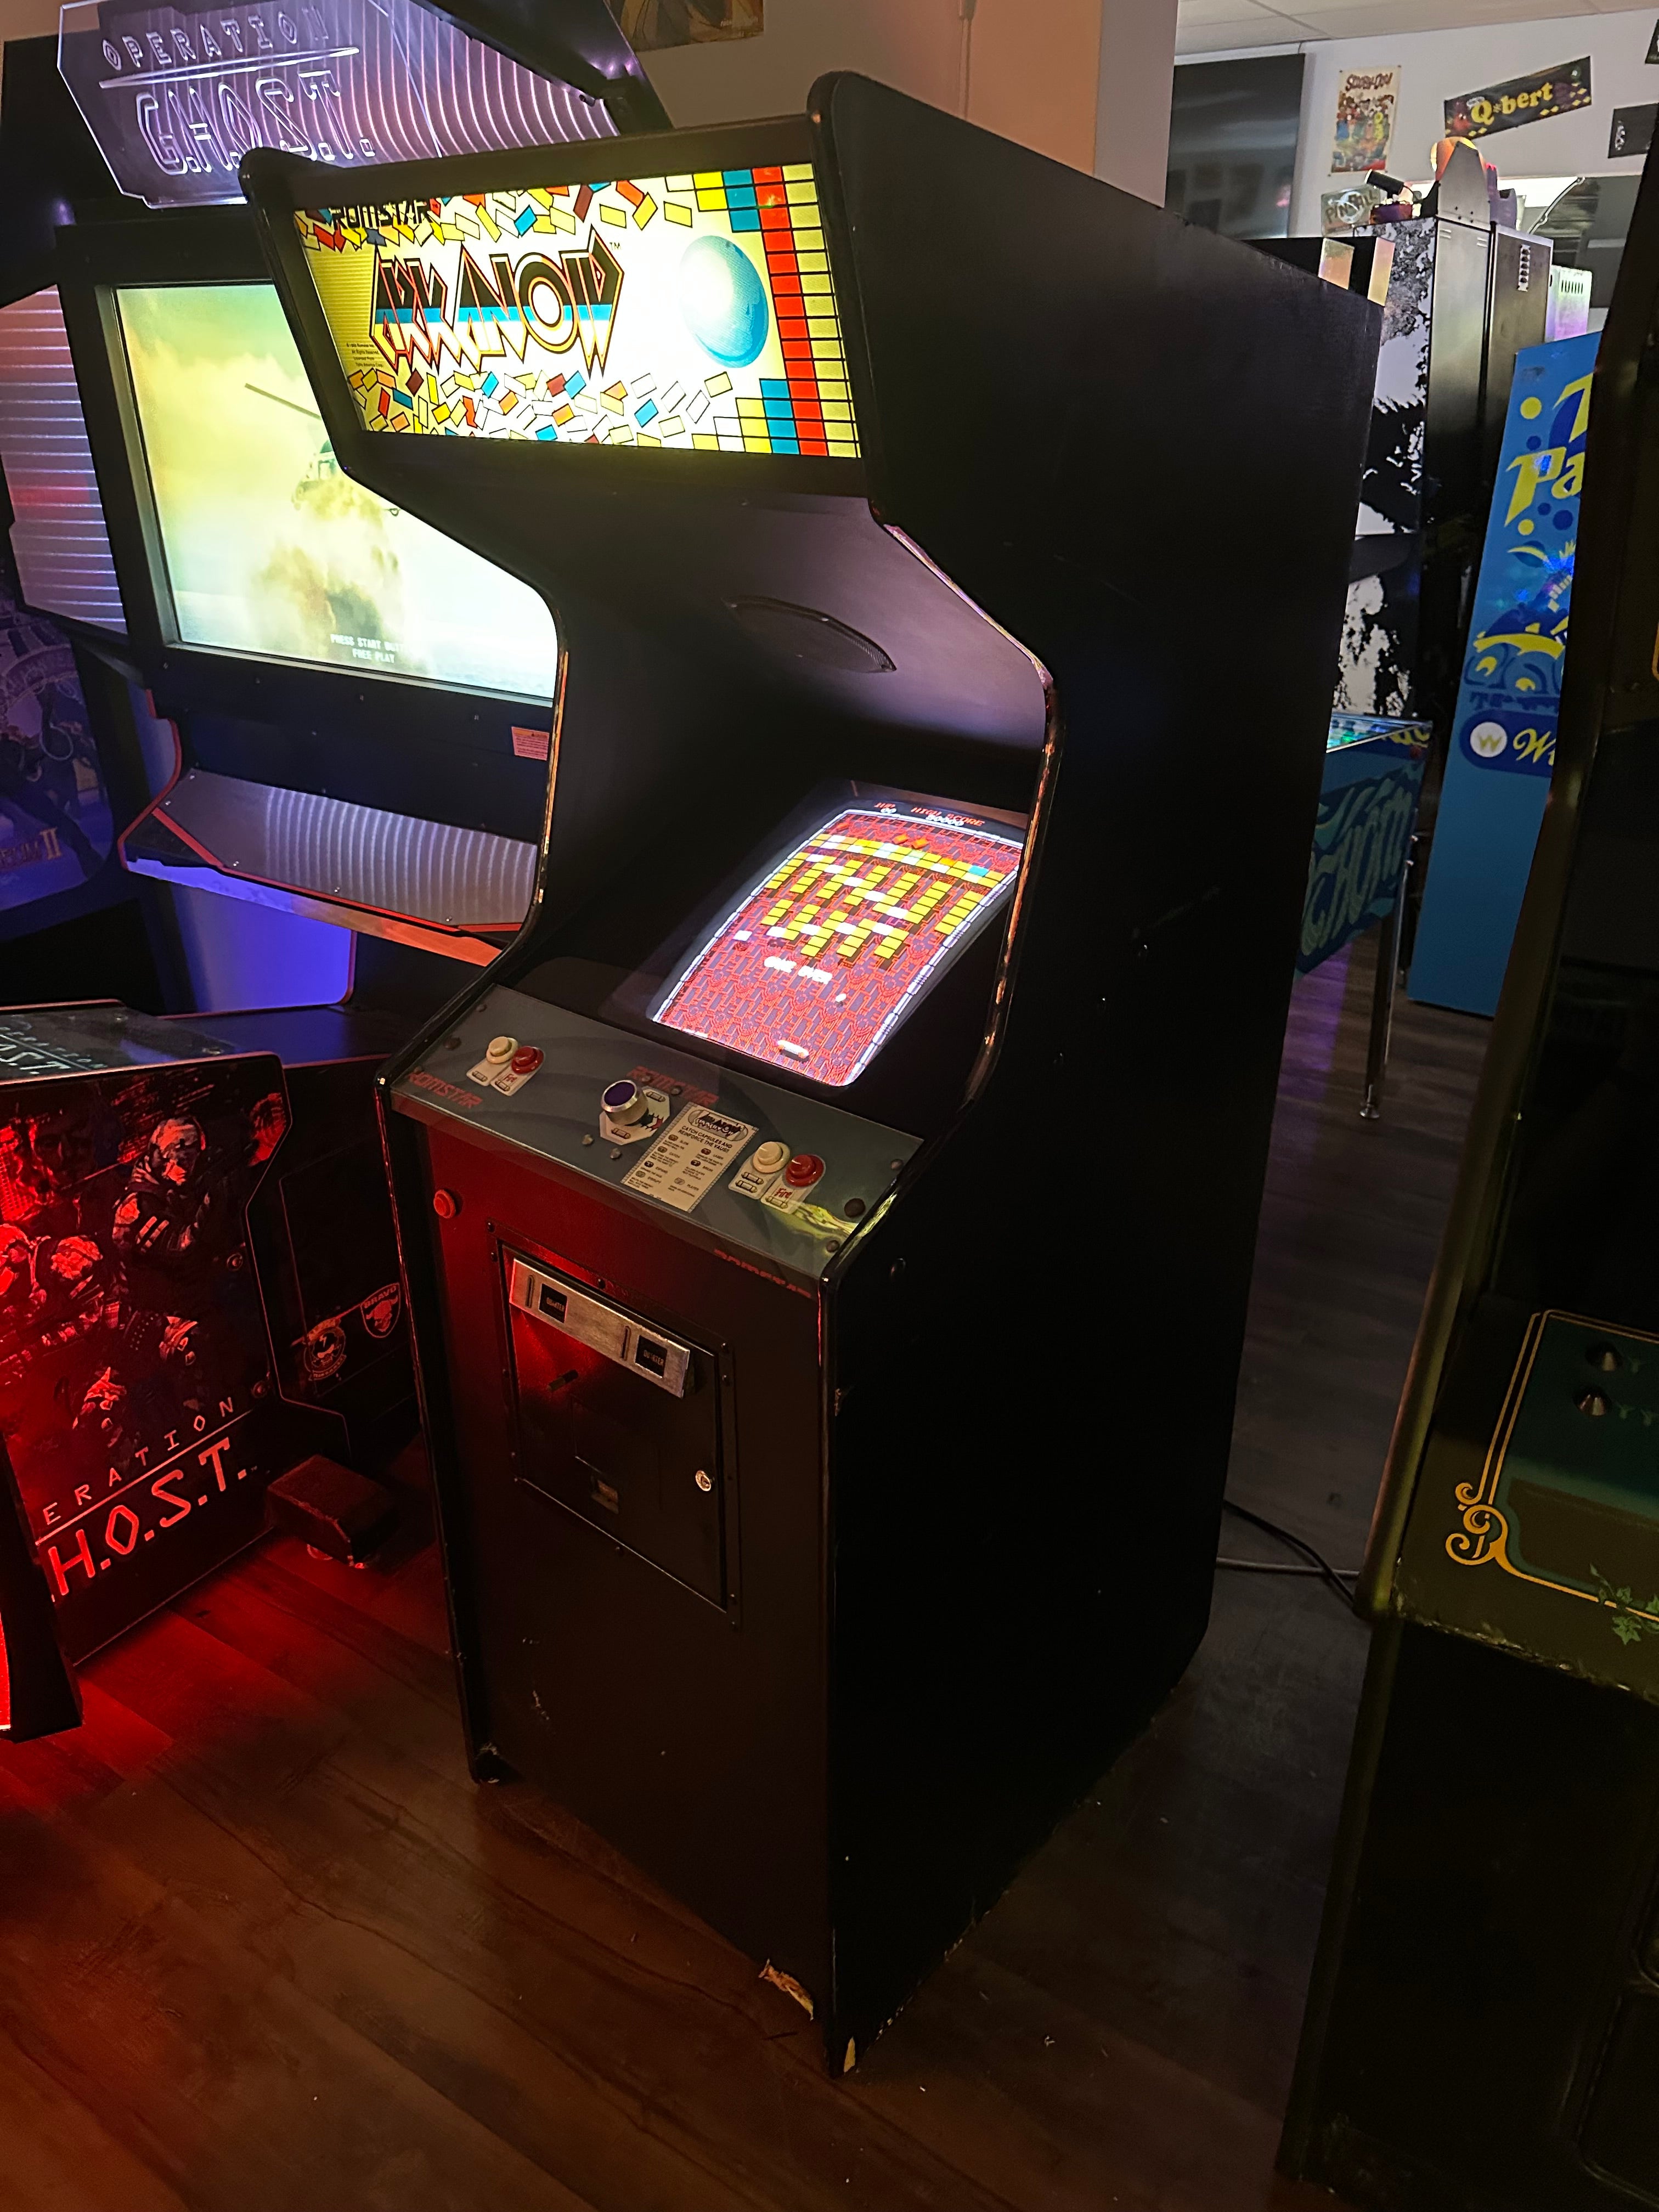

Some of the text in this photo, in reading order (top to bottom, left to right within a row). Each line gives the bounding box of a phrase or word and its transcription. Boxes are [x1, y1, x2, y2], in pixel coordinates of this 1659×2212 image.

[103, 5, 329, 70] OPERATION
[369, 223, 624, 380] ARKANOID
[1505, 447, 1585, 527] Pa
[1513, 728, 1556, 766] Wi
[678, 1129, 703, 1143] REINFORCE
[704, 1139, 714, 1147] THE
[681, 1126, 698, 1135] CATCH
[698, 1132, 722, 1145] CAPSULES
[774, 1188, 793, 1198] Fire
[364, 1285, 397, 1308] BRAVO
[43, 1397, 234, 1525] ERATION
